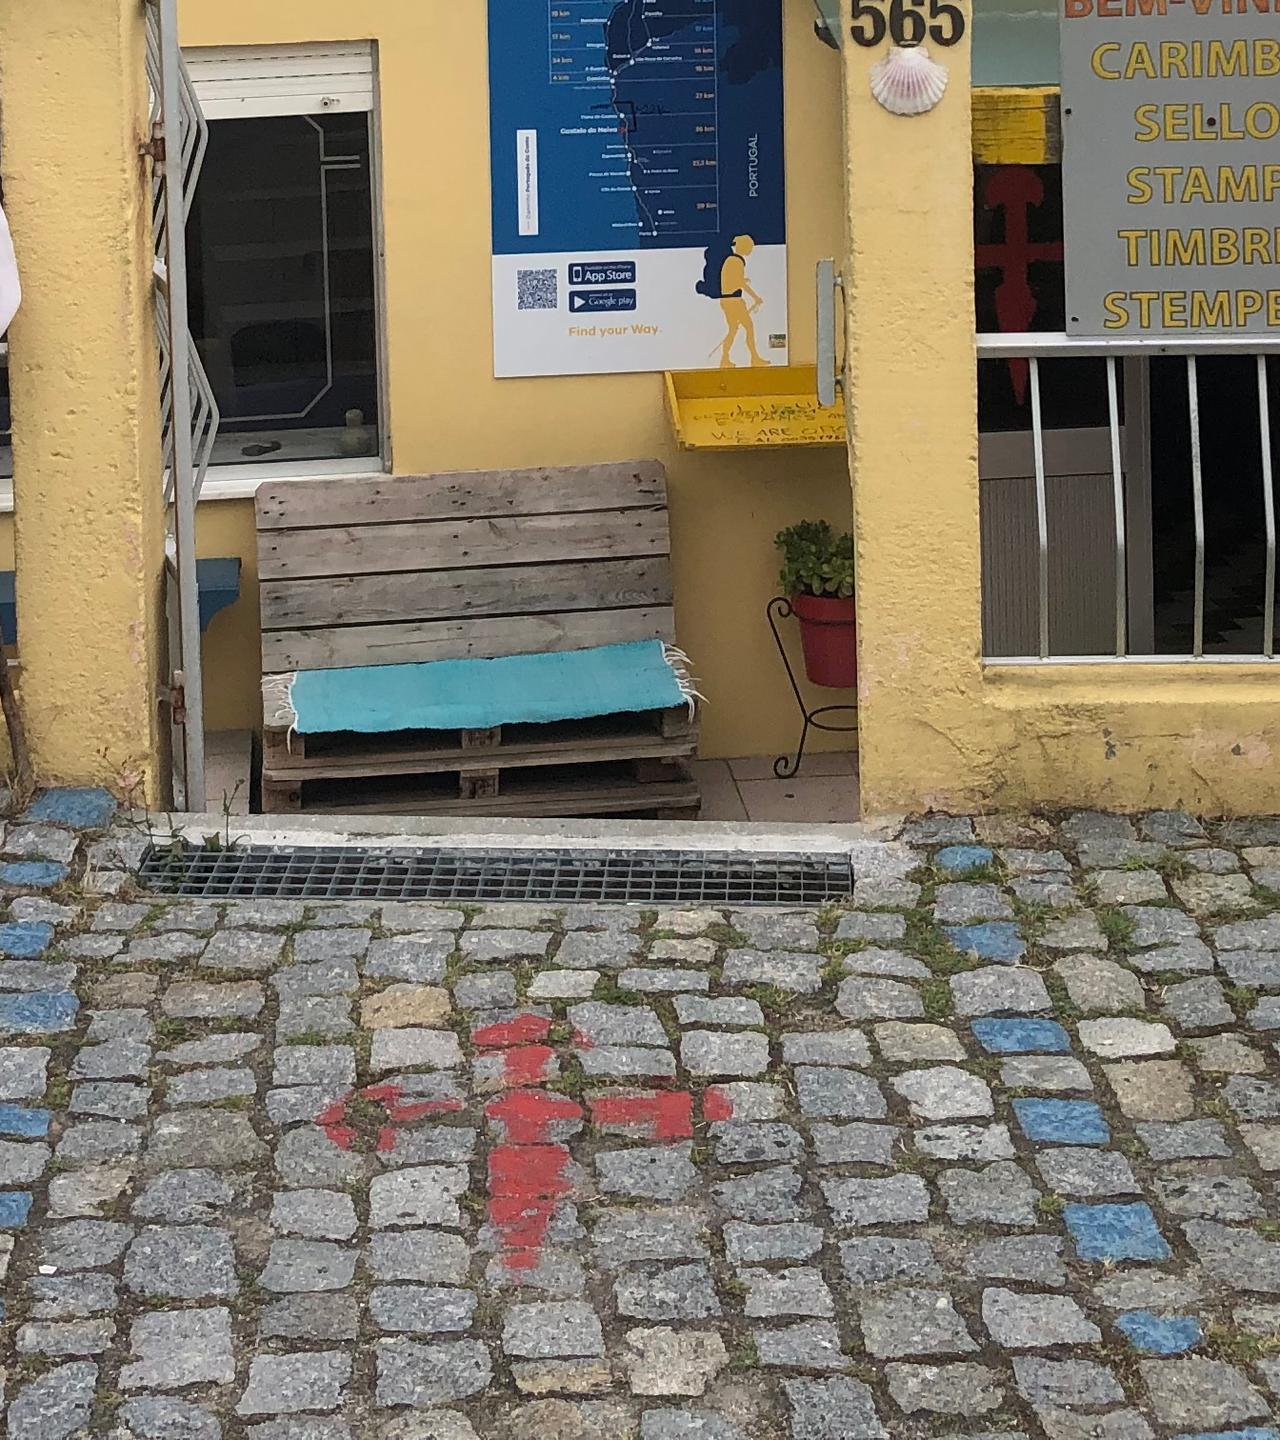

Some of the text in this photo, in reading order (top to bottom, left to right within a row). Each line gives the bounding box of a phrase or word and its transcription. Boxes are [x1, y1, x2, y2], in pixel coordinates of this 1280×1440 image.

[1135, 101, 1280, 143] SELLO
[748, 133, 758, 197] PORTUGAL
[585, 270, 632, 282] App Store
[588, 296, 633, 307] Google play
[568, 326, 596, 336] Find
[599, 327, 627, 337] your
